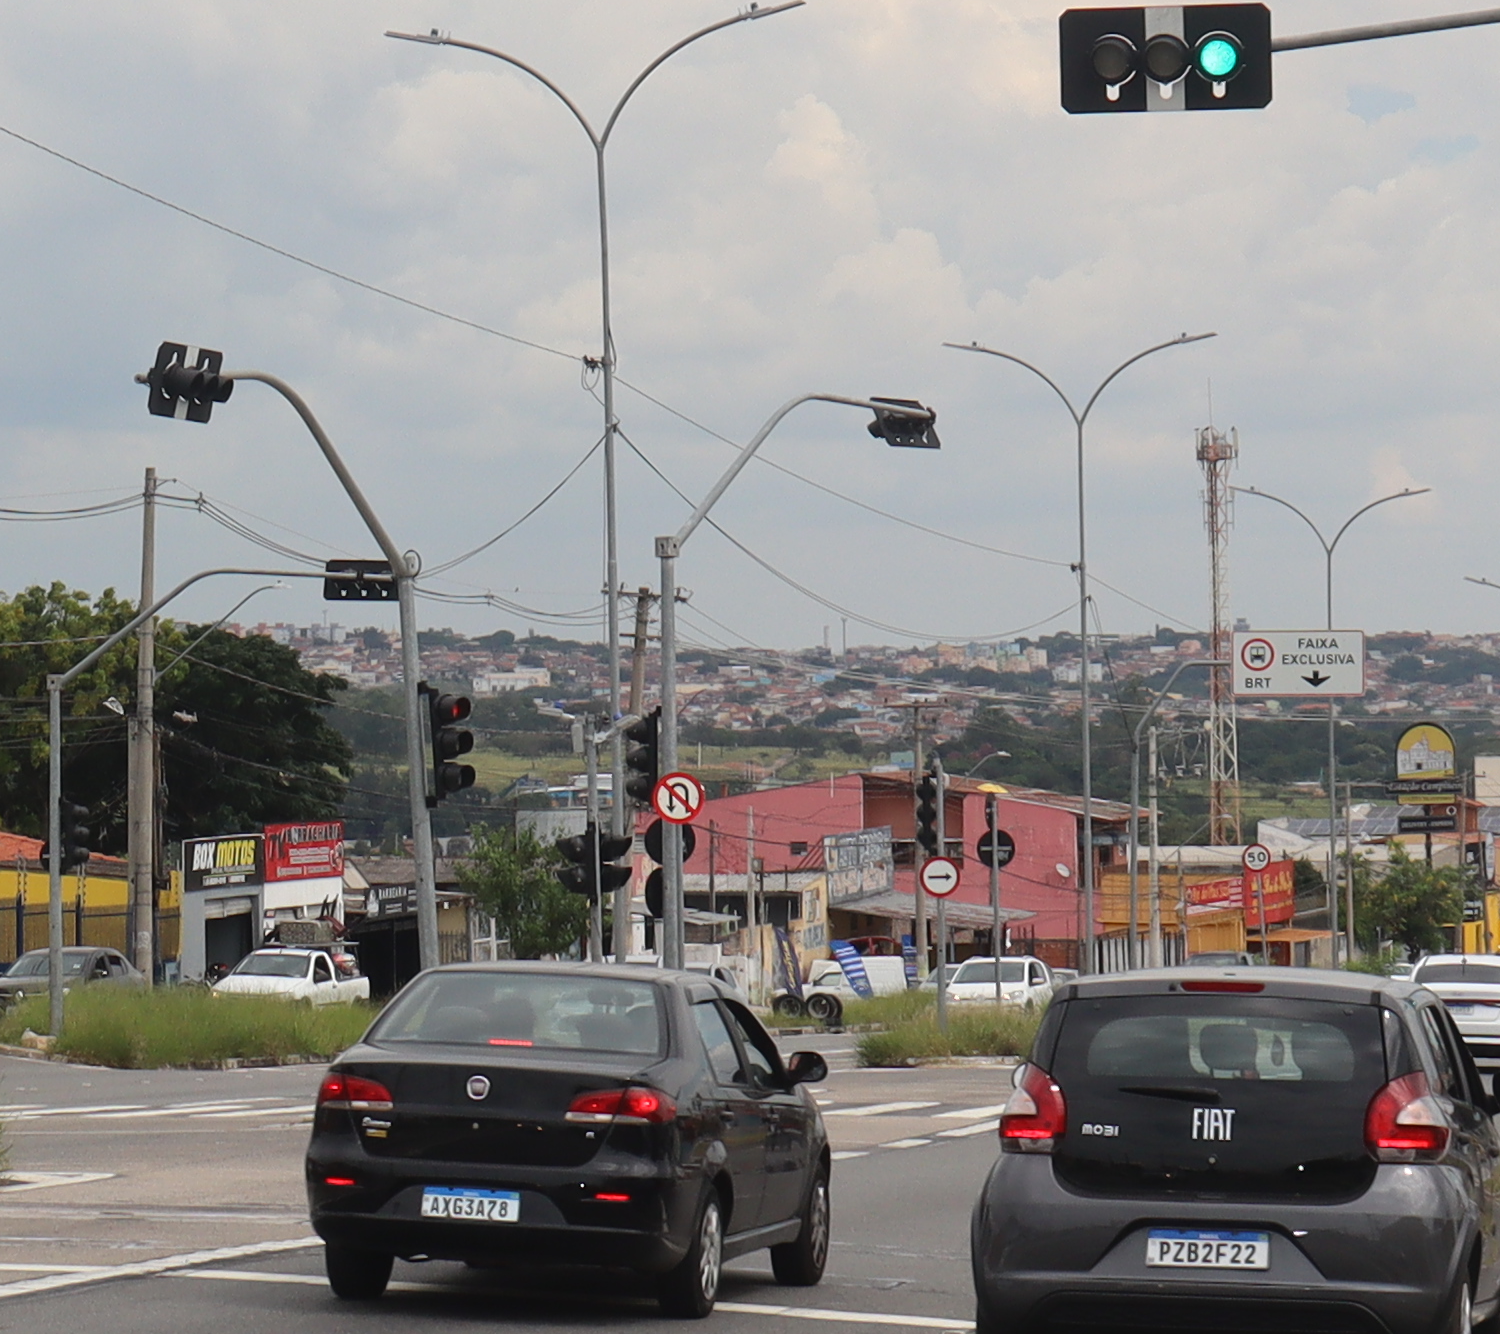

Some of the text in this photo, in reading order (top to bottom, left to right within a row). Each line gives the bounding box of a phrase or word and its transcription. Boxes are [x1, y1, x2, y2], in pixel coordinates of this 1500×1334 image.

[1297, 638, 1339, 649] FAIXA
[1281, 653, 1356, 665] EXCLUSIVA
[1245, 677, 1271, 689] BRT
[192, 842, 216, 871] BOX
[216, 839, 256, 868] MOTOS
[1247, 851, 1267, 863] 50
[1081, 1123, 1120, 1137] MOBI
[1191, 1107, 1236, 1141] FIAT
[429, 1196, 509, 1218] AXG3A78
[1159, 1241, 1257, 1264] PZB2F22
